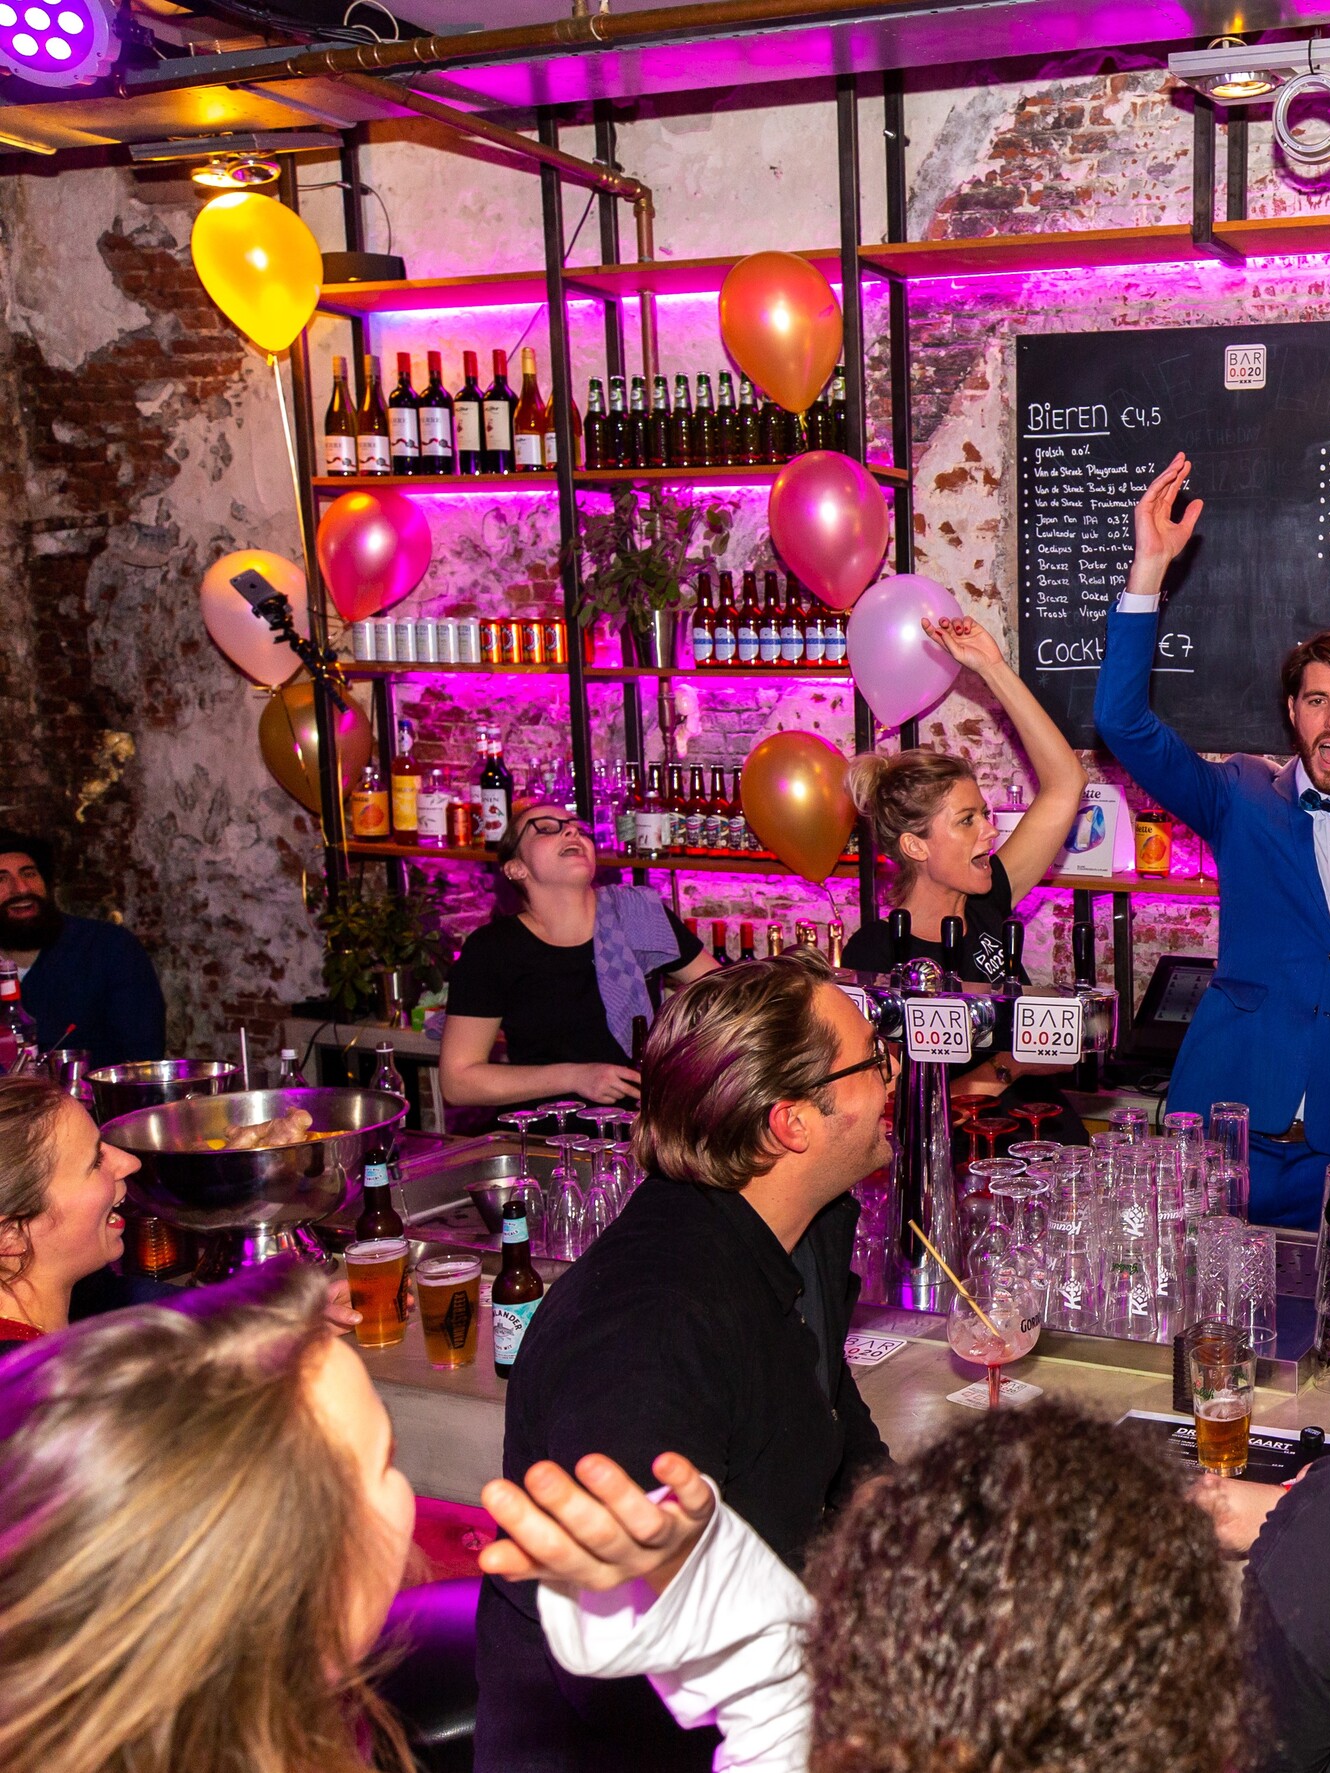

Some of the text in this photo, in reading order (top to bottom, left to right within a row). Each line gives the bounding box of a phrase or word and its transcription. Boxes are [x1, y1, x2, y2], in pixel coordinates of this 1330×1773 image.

[1230, 352, 1261, 365] BAR
[1230, 367, 1261, 377] 0.020
[1121, 407, 1161, 428] €4,5
[1052, 485, 1059, 493] de
[1051, 499, 1060, 507] de
[1083, 515, 1098, 525] IPA
[1109, 575, 1126, 585] IPA
[1158, 633, 1193, 657] €7
[912, 1009, 962, 1029] BAR
[1022, 1008, 1074, 1029] BAR
[914, 1030, 963, 1046] 0.020
[1022, 1030, 1074, 1046] 0.020
